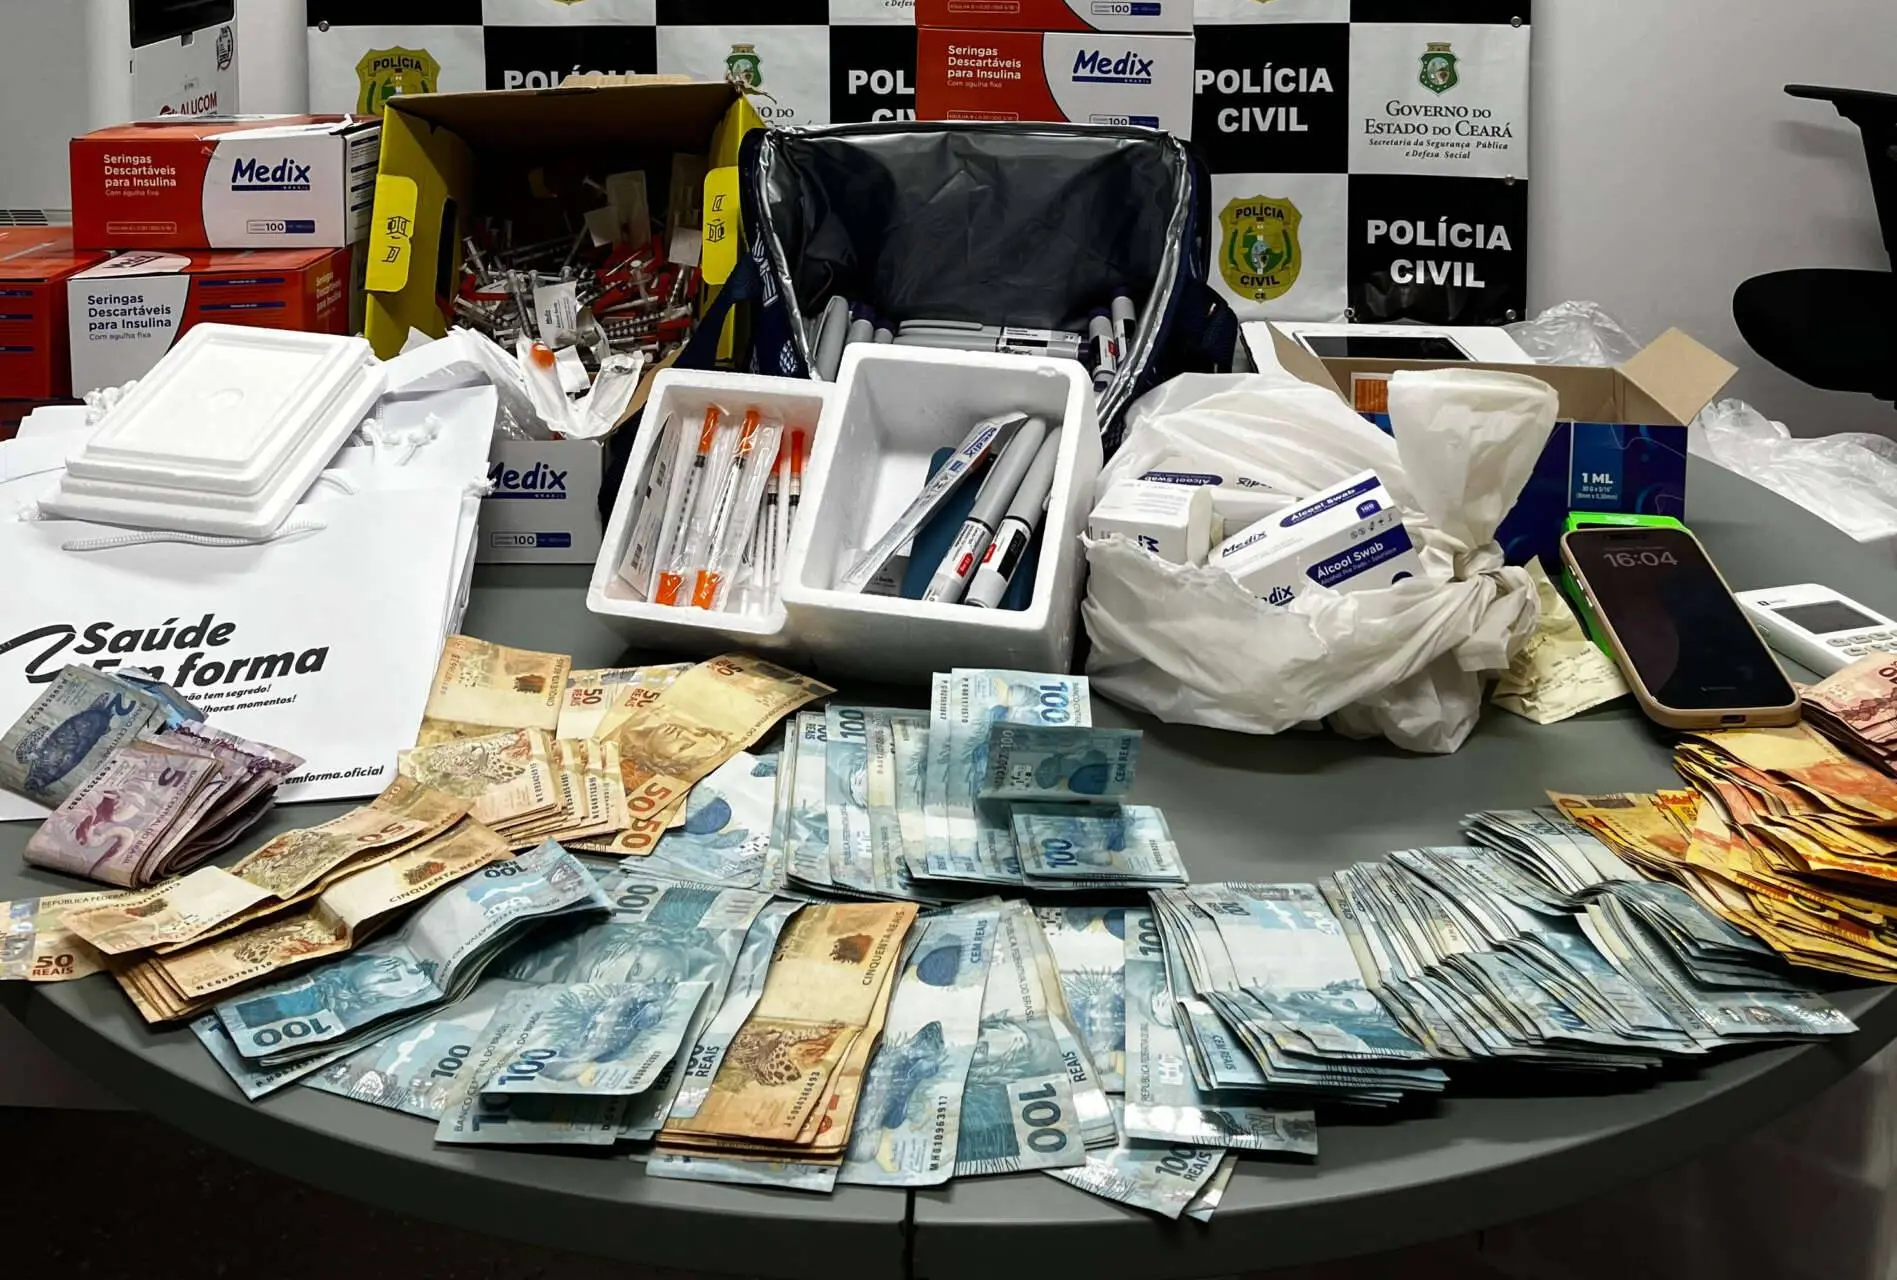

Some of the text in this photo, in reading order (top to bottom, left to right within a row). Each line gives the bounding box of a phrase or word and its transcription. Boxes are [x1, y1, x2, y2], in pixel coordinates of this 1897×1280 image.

[1111, 4, 1130, 13] 100
[948, 45, 998, 56] Seringas
[948, 57, 1021, 68] Descartáveis
[1072, 49, 1154, 76] Medix
[947, 68, 1021, 79] para Insulina
[1195, 63, 1333, 94] POLÍCIA
[1109, 117, 1128, 126] 100
[1218, 107, 1308, 132] CIVIL
[104, 154, 152, 165] Seringas
[104, 165, 176, 176] Descartáveis
[231, 158, 311, 184] Medix
[105, 176, 177, 188] para Insulina
[265, 222, 285, 231] 100
[1368, 216, 1512, 250] POLÍCIA
[1240, 274, 1281, 288] CIVIL
[1391, 259, 1485, 288] CIVIL
[87, 294, 144, 307] Seringas
[88, 305, 171, 319] Descartáveis
[89, 318, 172, 332] para Insulina
[1592, 473, 1614, 484] ML
[513, 535, 535, 545] 100
[1222, 531, 1267, 556] Medix
[1353, 542, 1384, 561] Swab
[1603, 551, 1678, 568] 16:04
[73, 613, 236, 654] Saúde
[173, 646, 330, 688] forma
[204, 692, 224, 700] tem
[225, 684, 272, 698] segredo!
[200, 694, 297, 713] lhores momentos!
[1039, 681, 1070, 723] 100
[280, 765, 384, 785] emforma.oficial
[1042, 838, 1078, 868] 100
[613, 884, 660, 917] 100
[36, 953, 73, 970] 50
[32, 966, 74, 978] REAIS
[253, 1019, 332, 1047] 100
[431, 1044, 472, 1079] 100
[498, 1048, 557, 1087] 100
[1018, 1082, 1067, 1153] 100
